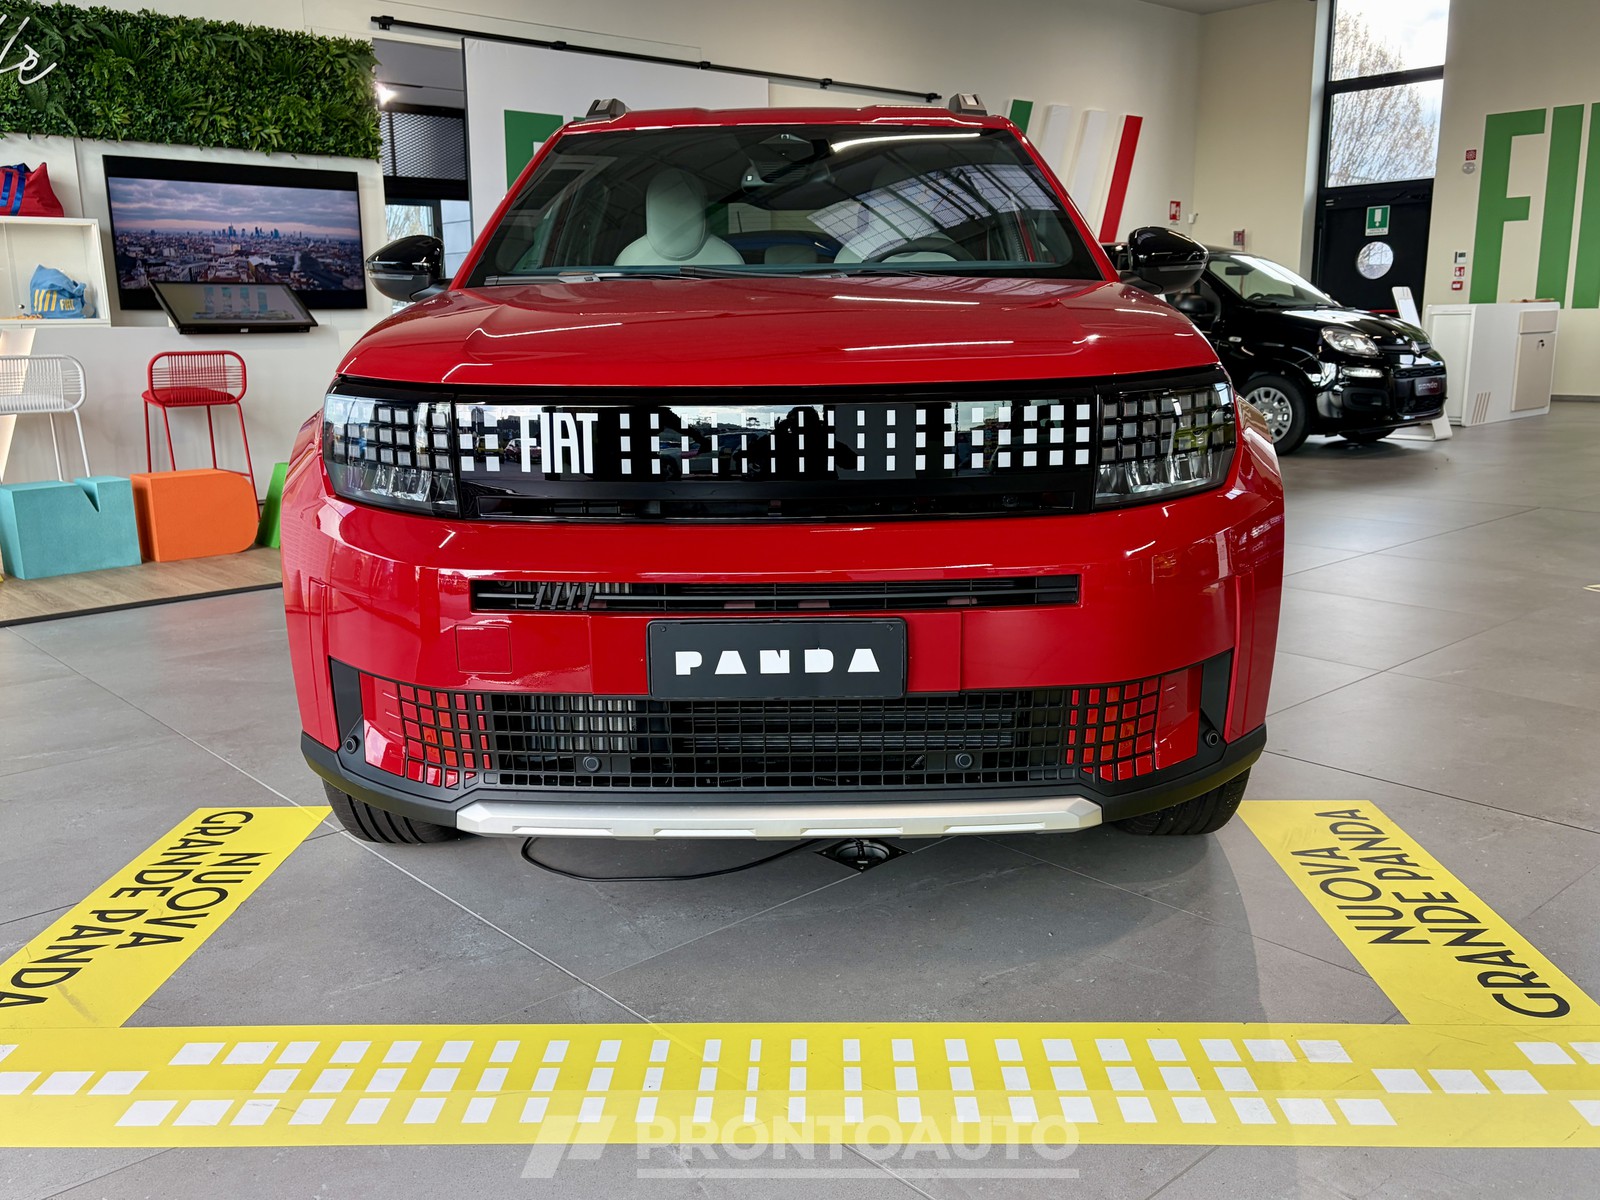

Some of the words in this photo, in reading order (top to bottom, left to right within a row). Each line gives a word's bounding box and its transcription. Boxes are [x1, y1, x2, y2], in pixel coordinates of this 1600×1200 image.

[520, 411, 599, 475] FIAT
[674, 647, 881, 676] PANDA
[109, 811, 254, 898] GRANDE
[1314, 808, 1435, 881] PANDA
[115, 852, 272, 949] NUOVA
[1290, 846, 1431, 945] NUOVA
[0, 908, 149, 1008] PANDA
[1391, 891, 1571, 1018] GRANDE
